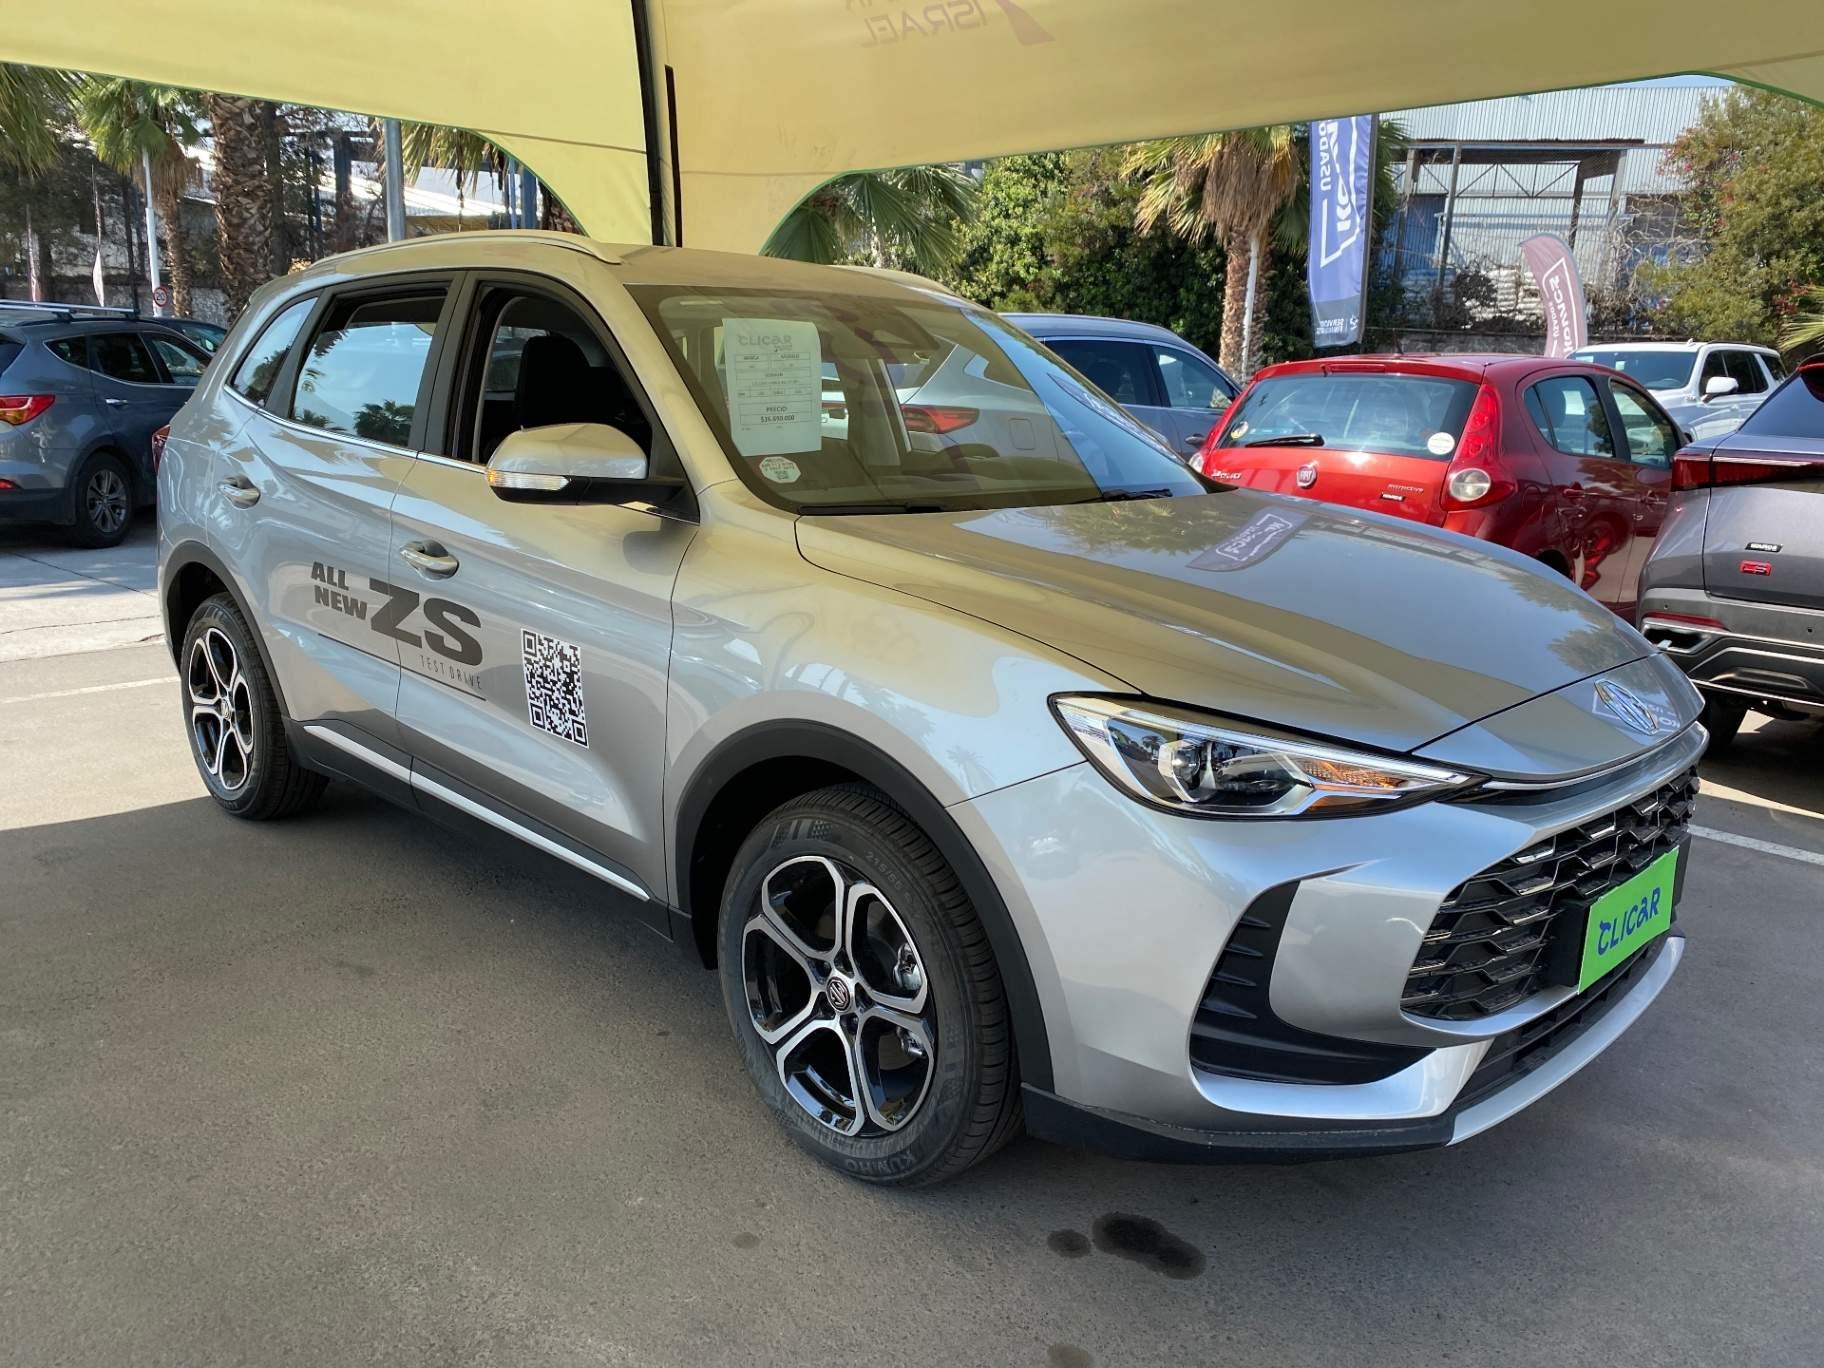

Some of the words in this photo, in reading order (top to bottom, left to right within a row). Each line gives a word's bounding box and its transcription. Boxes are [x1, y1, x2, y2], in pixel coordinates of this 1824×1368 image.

[311, 561, 349, 591] ALL
[314, 585, 368, 620] NEW
[369, 577, 484, 667] ZS
[419, 654, 447, 676] TEST
[449, 666, 483, 690] DRIVE
